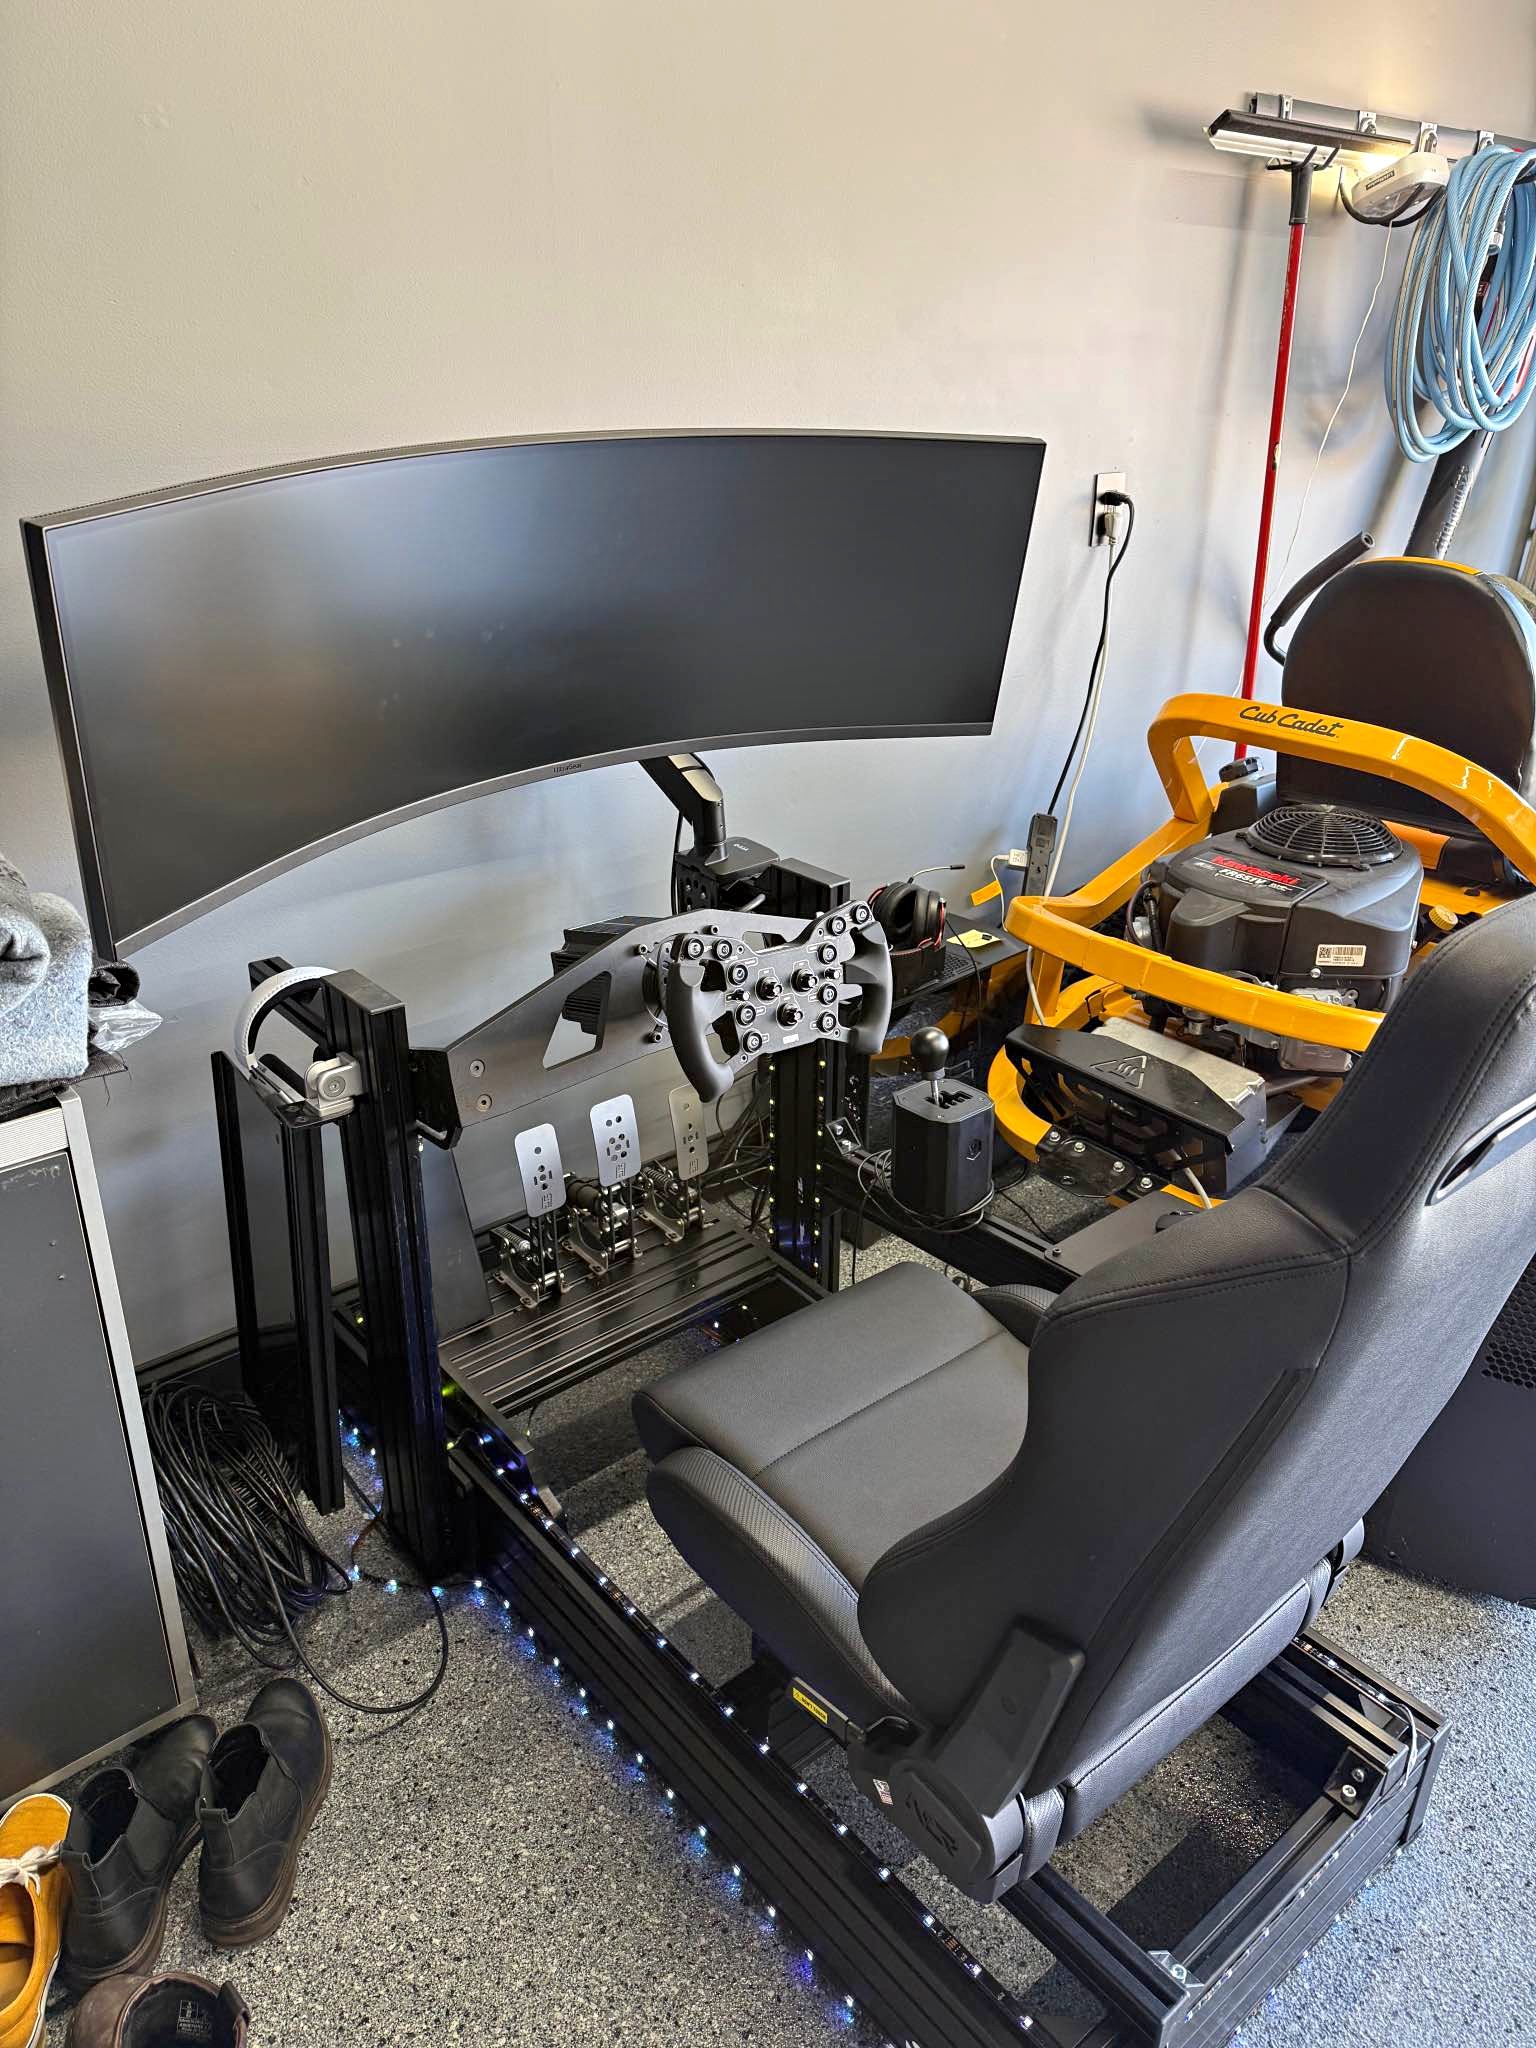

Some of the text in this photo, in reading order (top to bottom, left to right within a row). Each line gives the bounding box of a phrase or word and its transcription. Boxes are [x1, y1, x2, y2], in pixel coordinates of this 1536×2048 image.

[1239, 706, 1344, 737] Cub Cadet
[1210, 855, 1300, 886] Kawasaki
